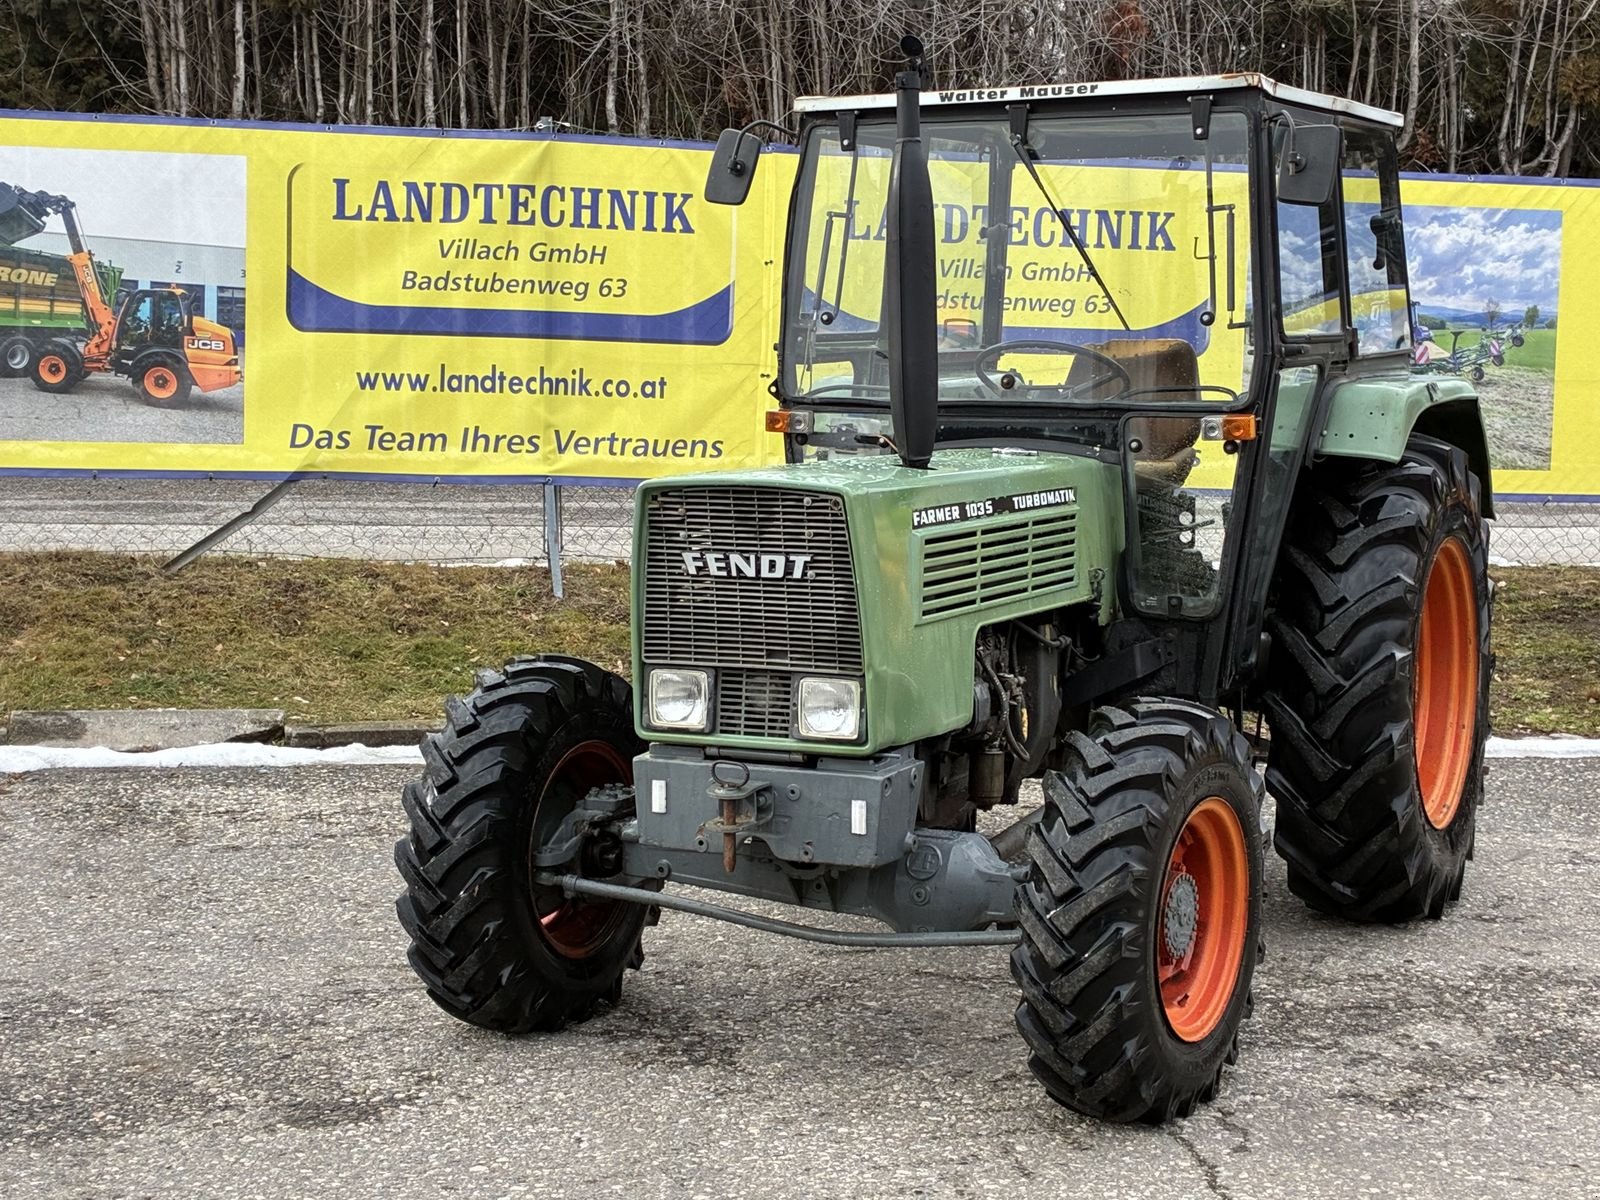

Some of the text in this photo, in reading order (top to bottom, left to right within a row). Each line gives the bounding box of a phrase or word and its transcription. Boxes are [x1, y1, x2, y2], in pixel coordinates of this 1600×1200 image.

[939, 83, 1099, 103] Walter Mauser
[332, 178, 695, 234] LANDTECHNIK
[438, 238, 608, 265] Villach GmbH
[0, 265, 58, 287] RONE
[1021, 260, 1096, 282] GmbH
[401, 271, 628, 301] Badstubenweg 63
[1084, 294, 1112, 314] 63
[188, 339, 225, 351] JCB
[355, 363, 668, 400] www.landtechnik.co.at
[289, 423, 725, 459] Das Team Ihres Vertrauens
[912, 488, 1076, 527] FARMER 1035 TURBOMATIK
[681, 550, 813, 579] FENDT
